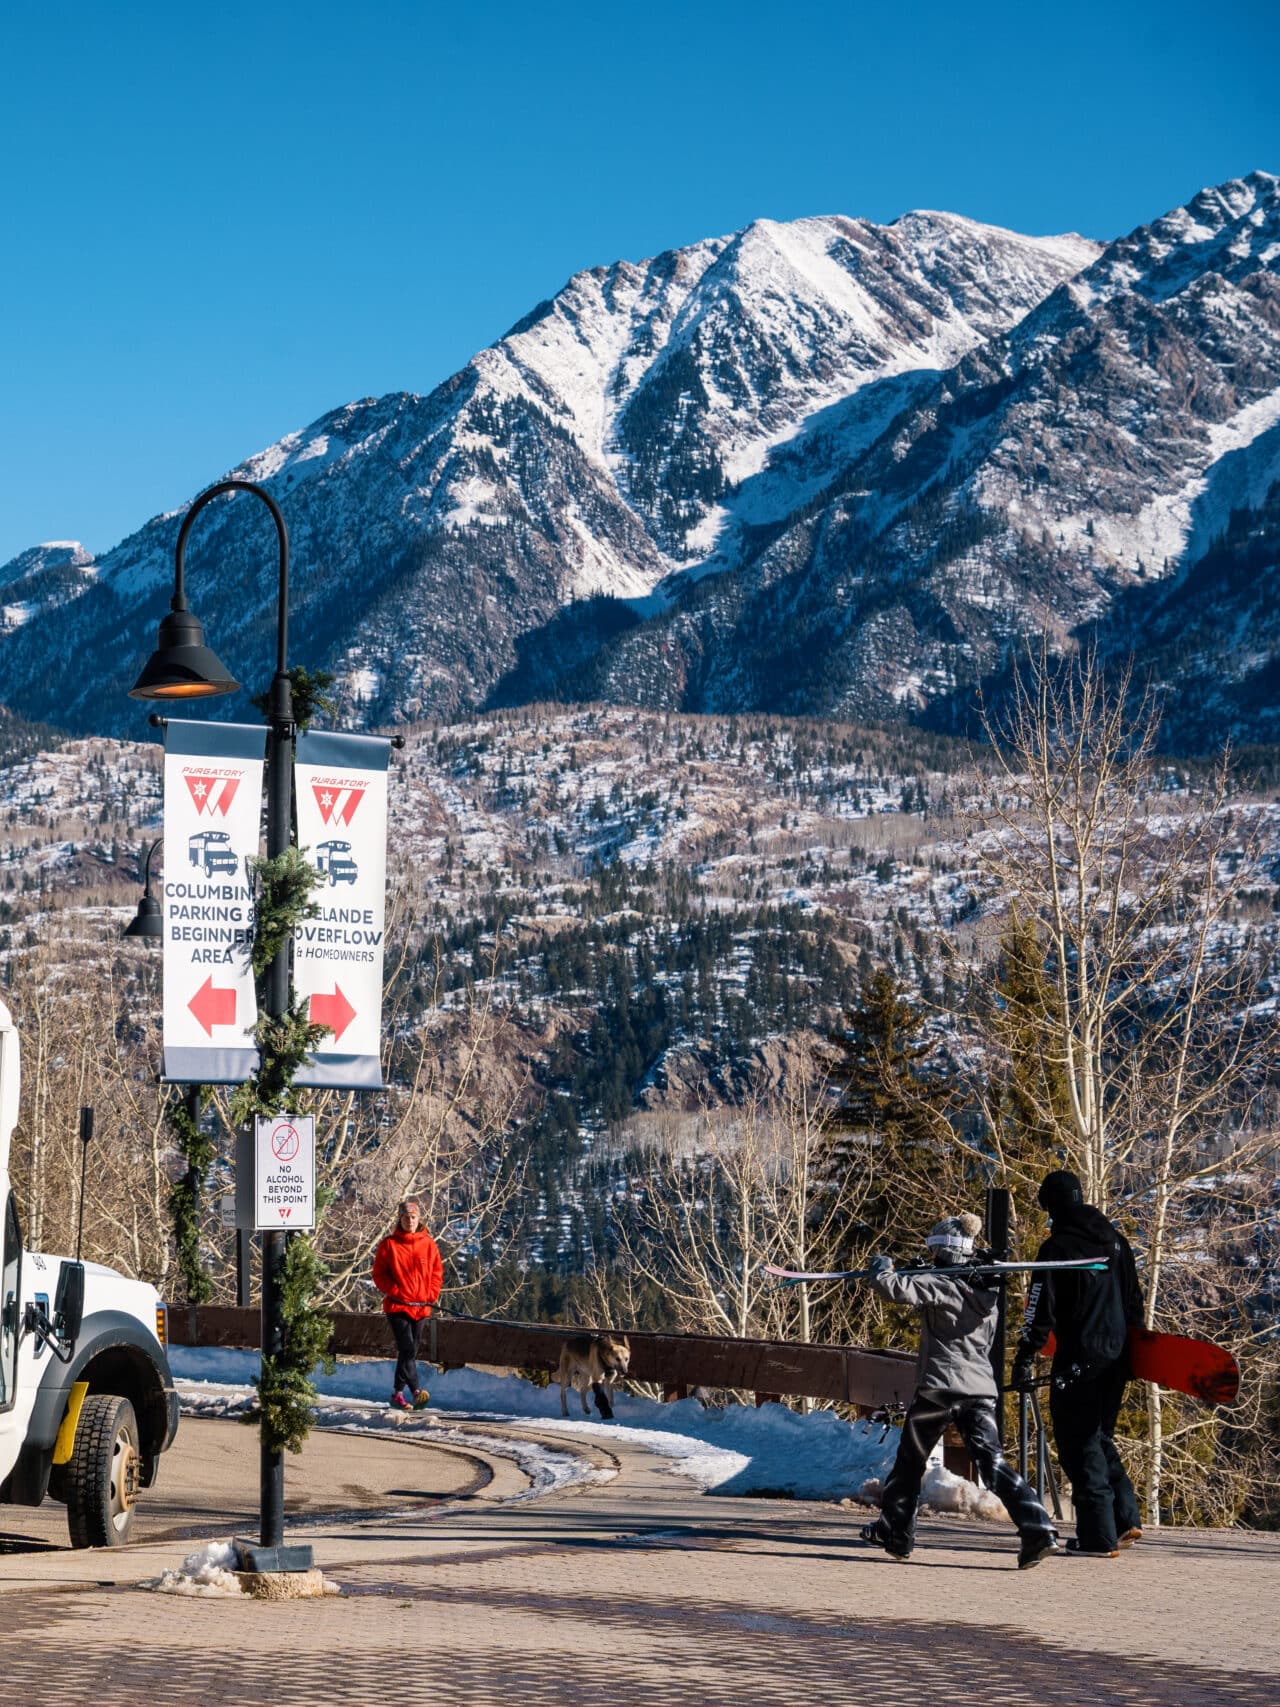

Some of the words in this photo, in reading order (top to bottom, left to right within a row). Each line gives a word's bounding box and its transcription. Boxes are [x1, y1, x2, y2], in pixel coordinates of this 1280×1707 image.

[182, 767, 245, 777] PURGATORY
[310, 776, 370, 787] PURGATORY
[165, 883, 255, 901] COLUMBIN
[170, 905, 242, 921] PARKING
[295, 926, 382, 945] OVERFLOW
[191, 948, 233, 964] AREA
[297, 947, 302, 957] &
[306, 947, 374, 962] HOMEOWNERS
[280, 1165, 291, 1173] NO
[266, 1175, 304, 1183] ALCOHOL
[268, 1185, 302, 1193] BEYOND
[263, 1195, 281, 1203] THIS
[283, 1195, 308, 1203] POINT
